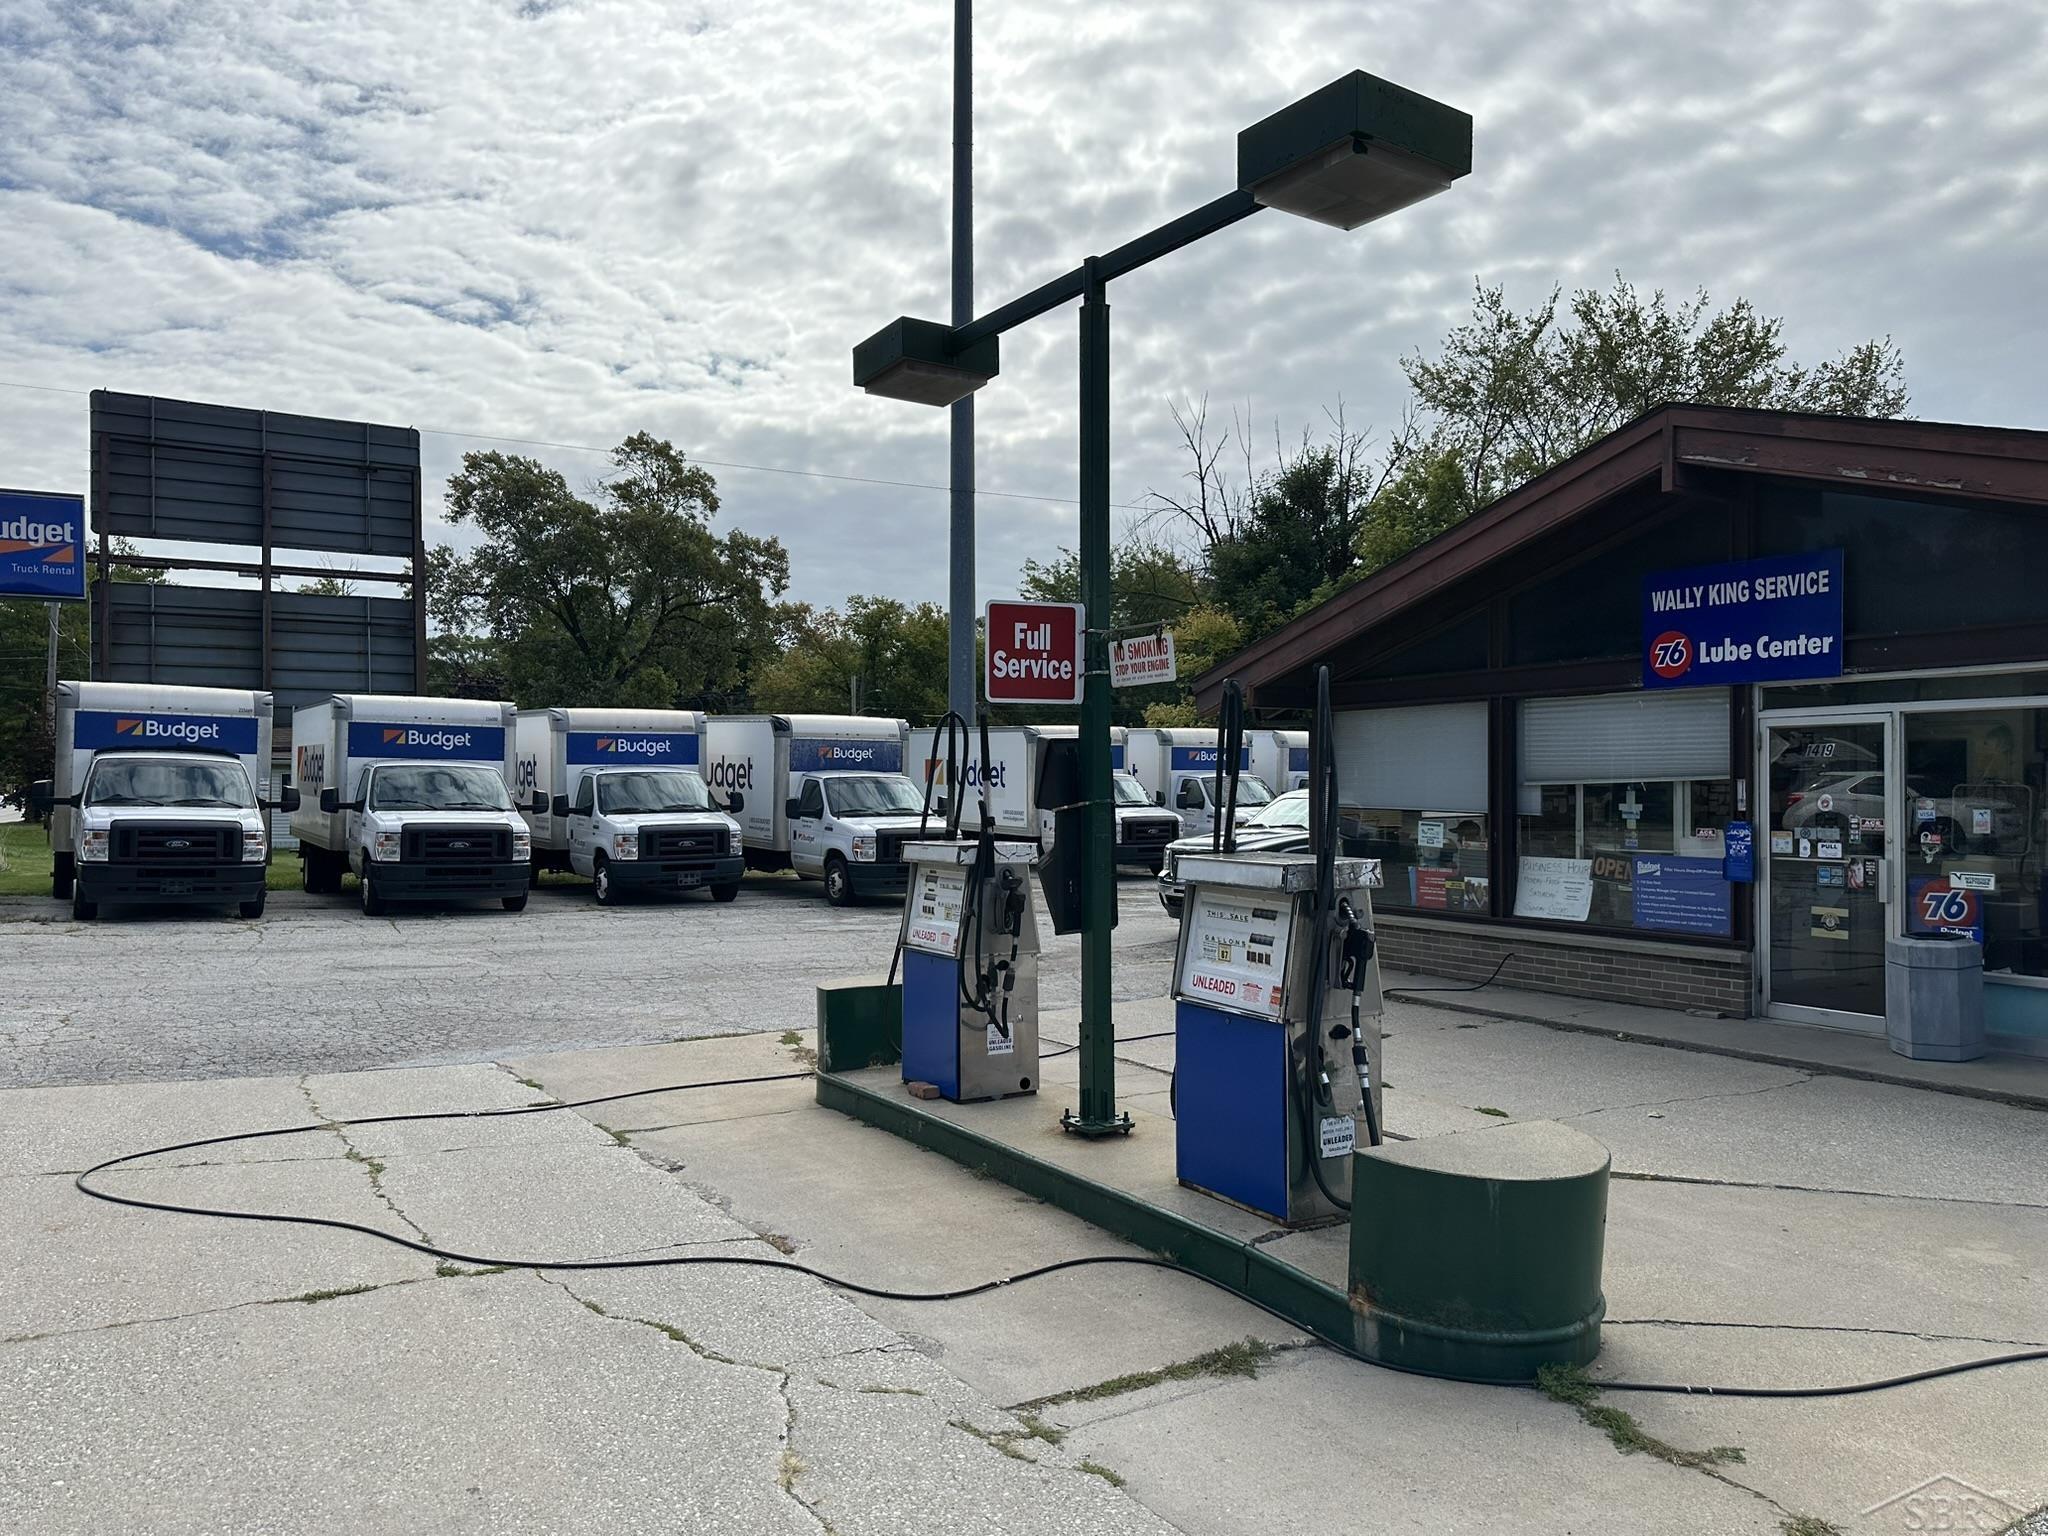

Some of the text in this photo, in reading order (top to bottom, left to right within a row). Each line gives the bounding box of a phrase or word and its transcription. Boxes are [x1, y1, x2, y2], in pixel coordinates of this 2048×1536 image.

[12, 563, 75, 575] Truck Rental
[1652, 569, 1830, 612] WALLY KING SERVICE
[1014, 622, 1051, 650] Full
[1113, 637, 1169, 663] NO SMOKING
[1654, 634, 1834, 668] 76 Lube Center
[992, 649, 1073, 680] Service
[1115, 658, 1170, 676] STOP YOUR ENGINE
[146, 720, 219, 743] Budget
[408, 730, 471, 750] Budget
[617, 738, 671, 756] Budget
[833, 747, 873, 762] Budget
[1807, 744, 1834, 757] 1419
[1923, 889, 1968, 922] 76
[1230, 913, 1248, 921] SALE
[912, 928, 937, 942] UNLEADED
[1204, 934, 1246, 948] GALLONS
[1192, 974, 1236, 995] UNLEADED
[1323, 1133, 1353, 1146] UNLEADED
